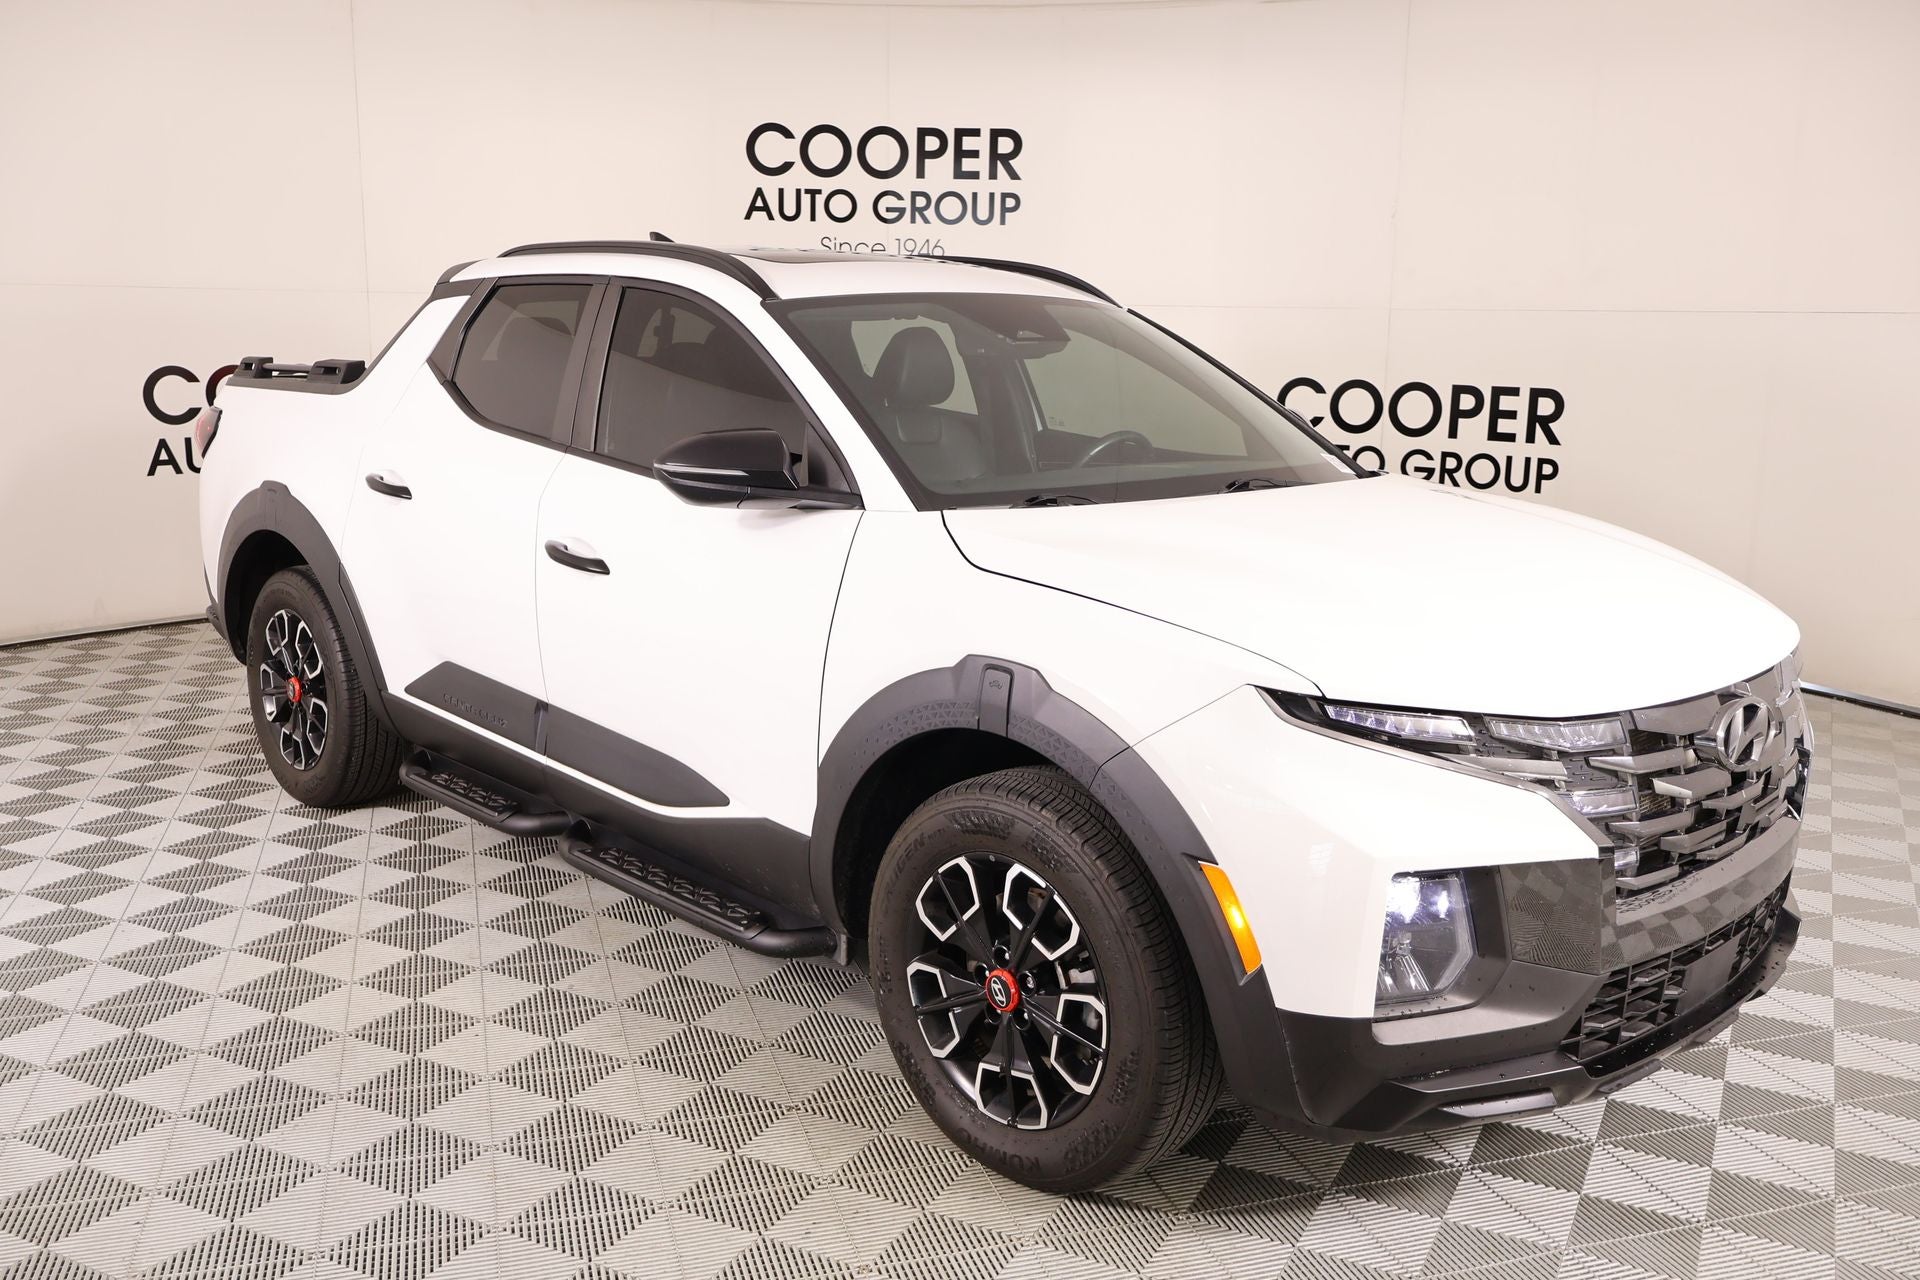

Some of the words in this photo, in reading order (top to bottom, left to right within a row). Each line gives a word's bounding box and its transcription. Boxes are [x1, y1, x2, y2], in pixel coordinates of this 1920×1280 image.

[746, 122, 1023, 181] COOPER
[744, 187, 858, 223] AUTO
[872, 190, 1021, 226] GROUP
[820, 236, 886, 253] Since
[895, 238, 945, 256] 1946
[1277, 377, 1565, 446] COOPER
[1400, 448, 1559, 494] GROUP
